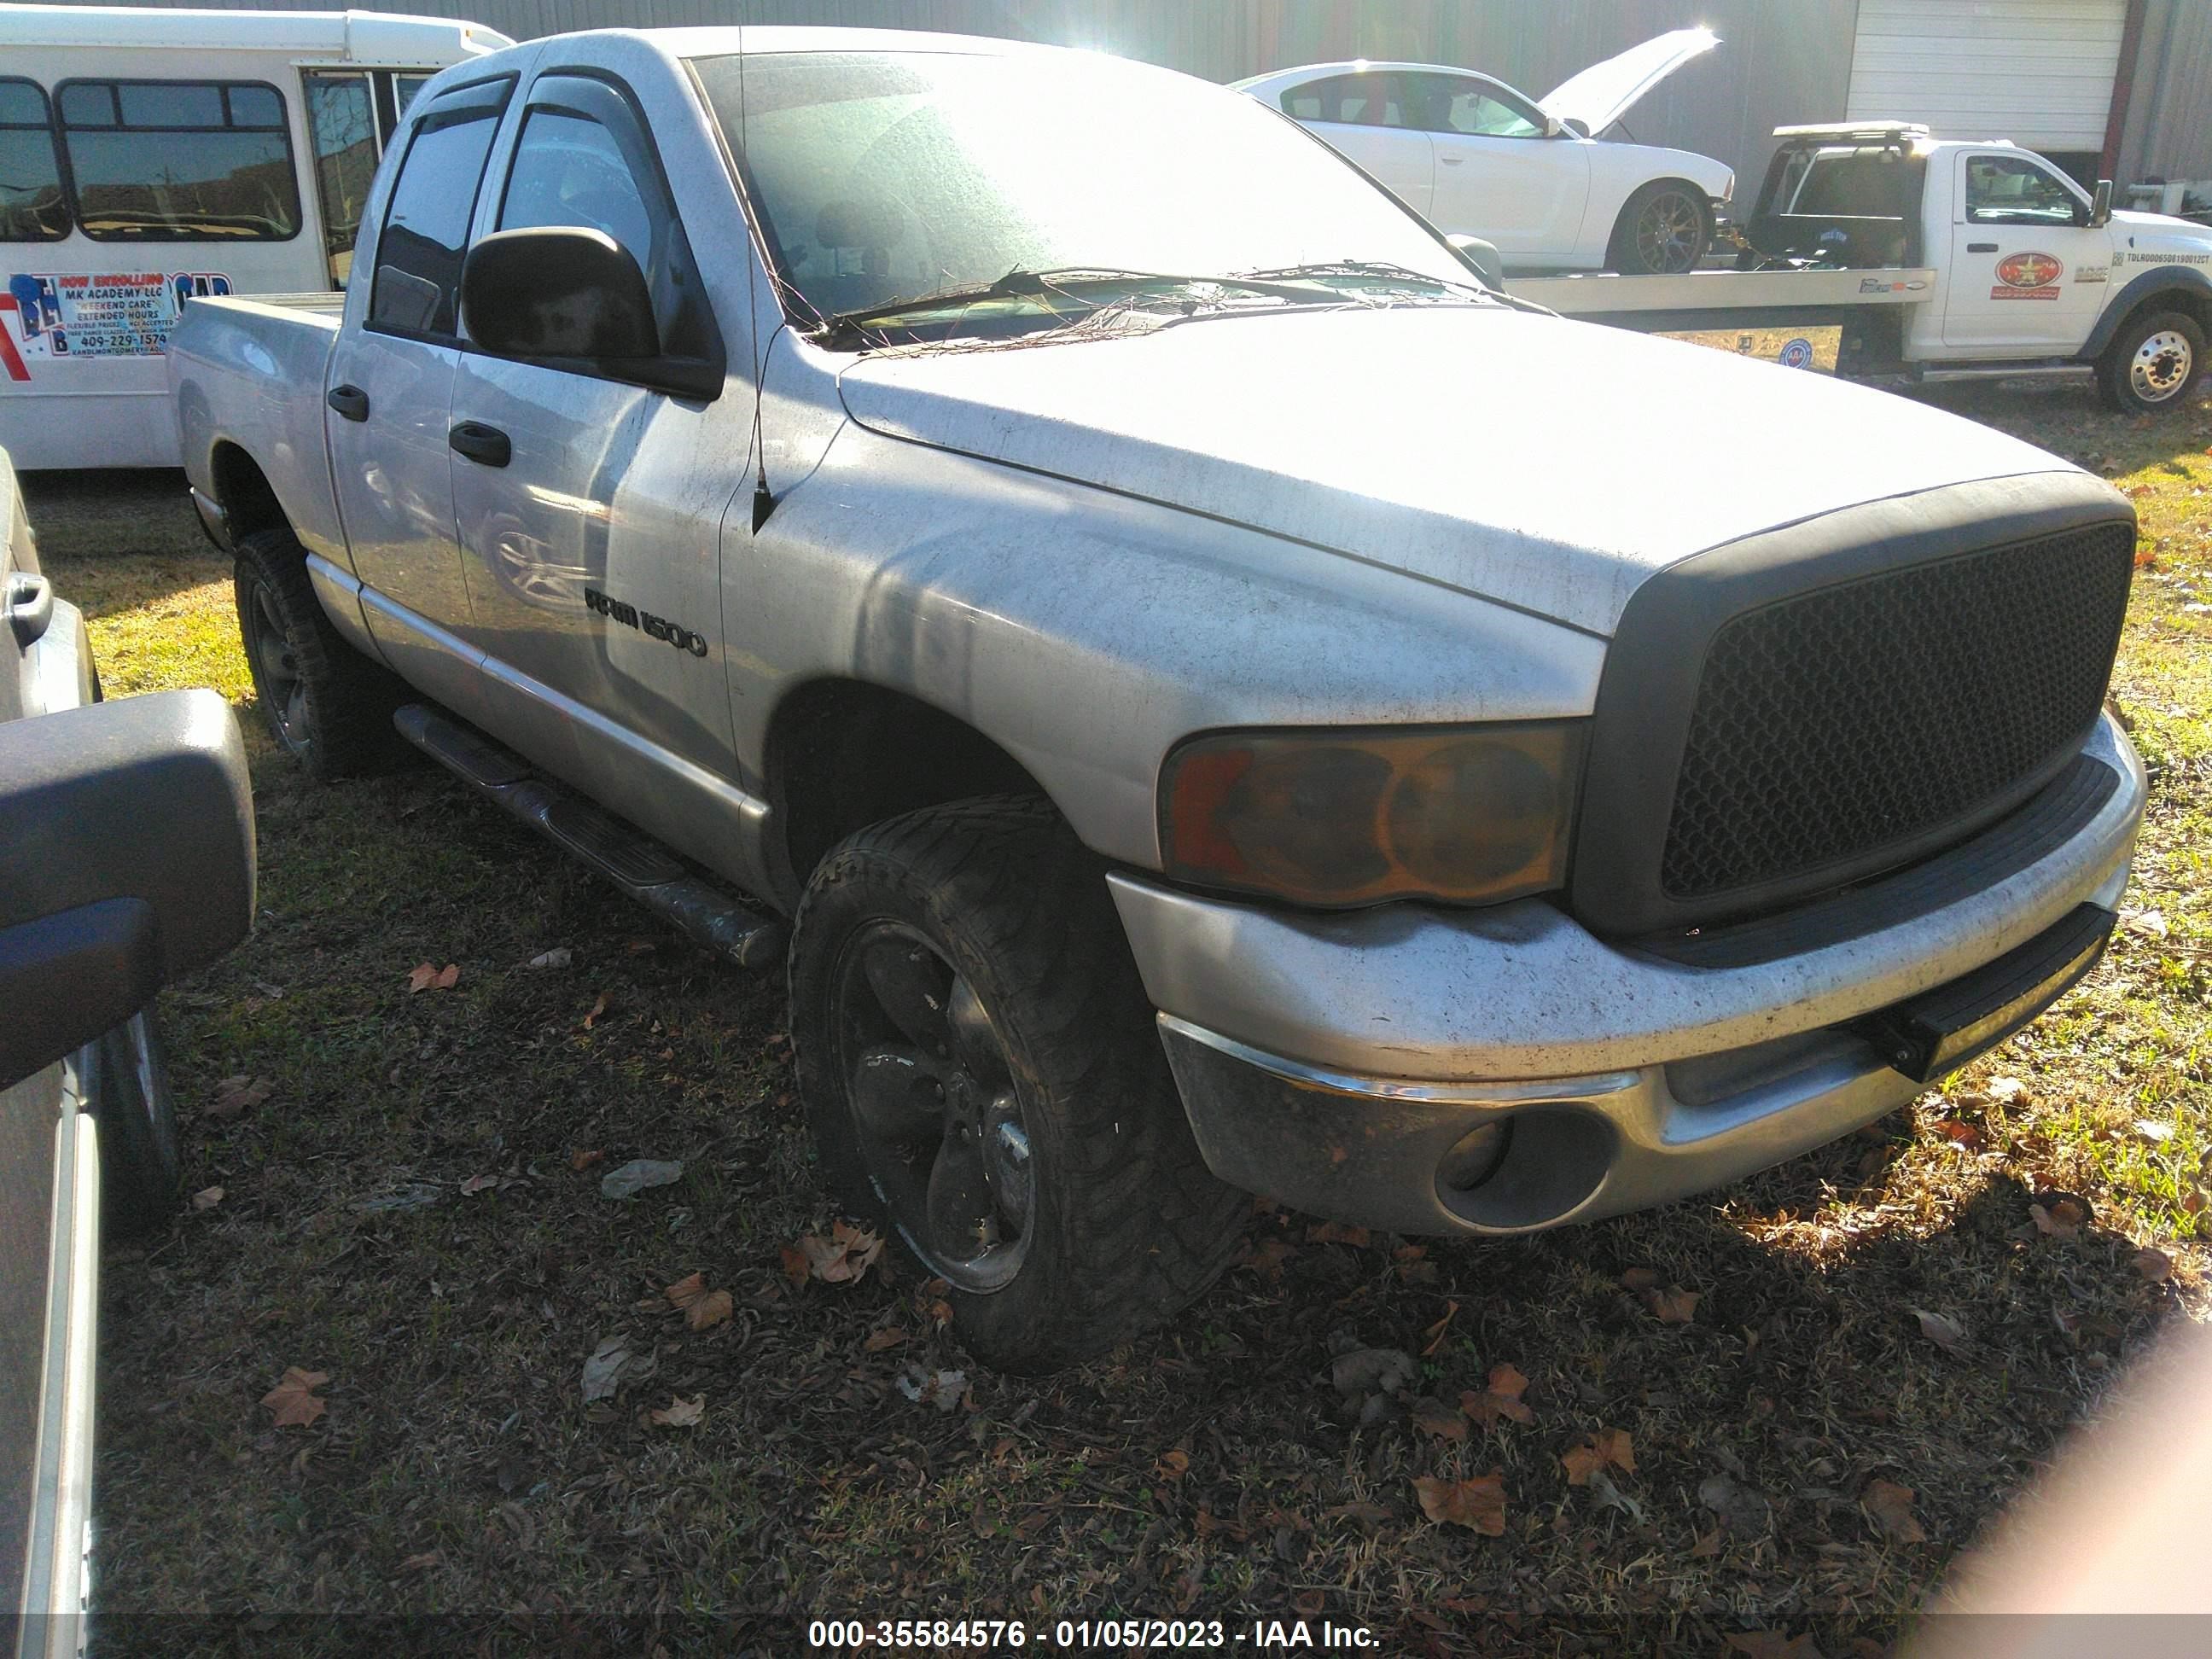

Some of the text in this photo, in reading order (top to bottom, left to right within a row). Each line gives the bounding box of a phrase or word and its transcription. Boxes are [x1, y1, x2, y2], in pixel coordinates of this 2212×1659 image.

[59, 273, 164, 288] NOW ENROLLING
[66, 287, 162, 300] MK ACADEMY LLC
[77, 311, 159, 321] EXTENDED HOURS
[80, 334, 167, 346] 409-229-1574
[585, 586, 708, 657] RAM 1500
